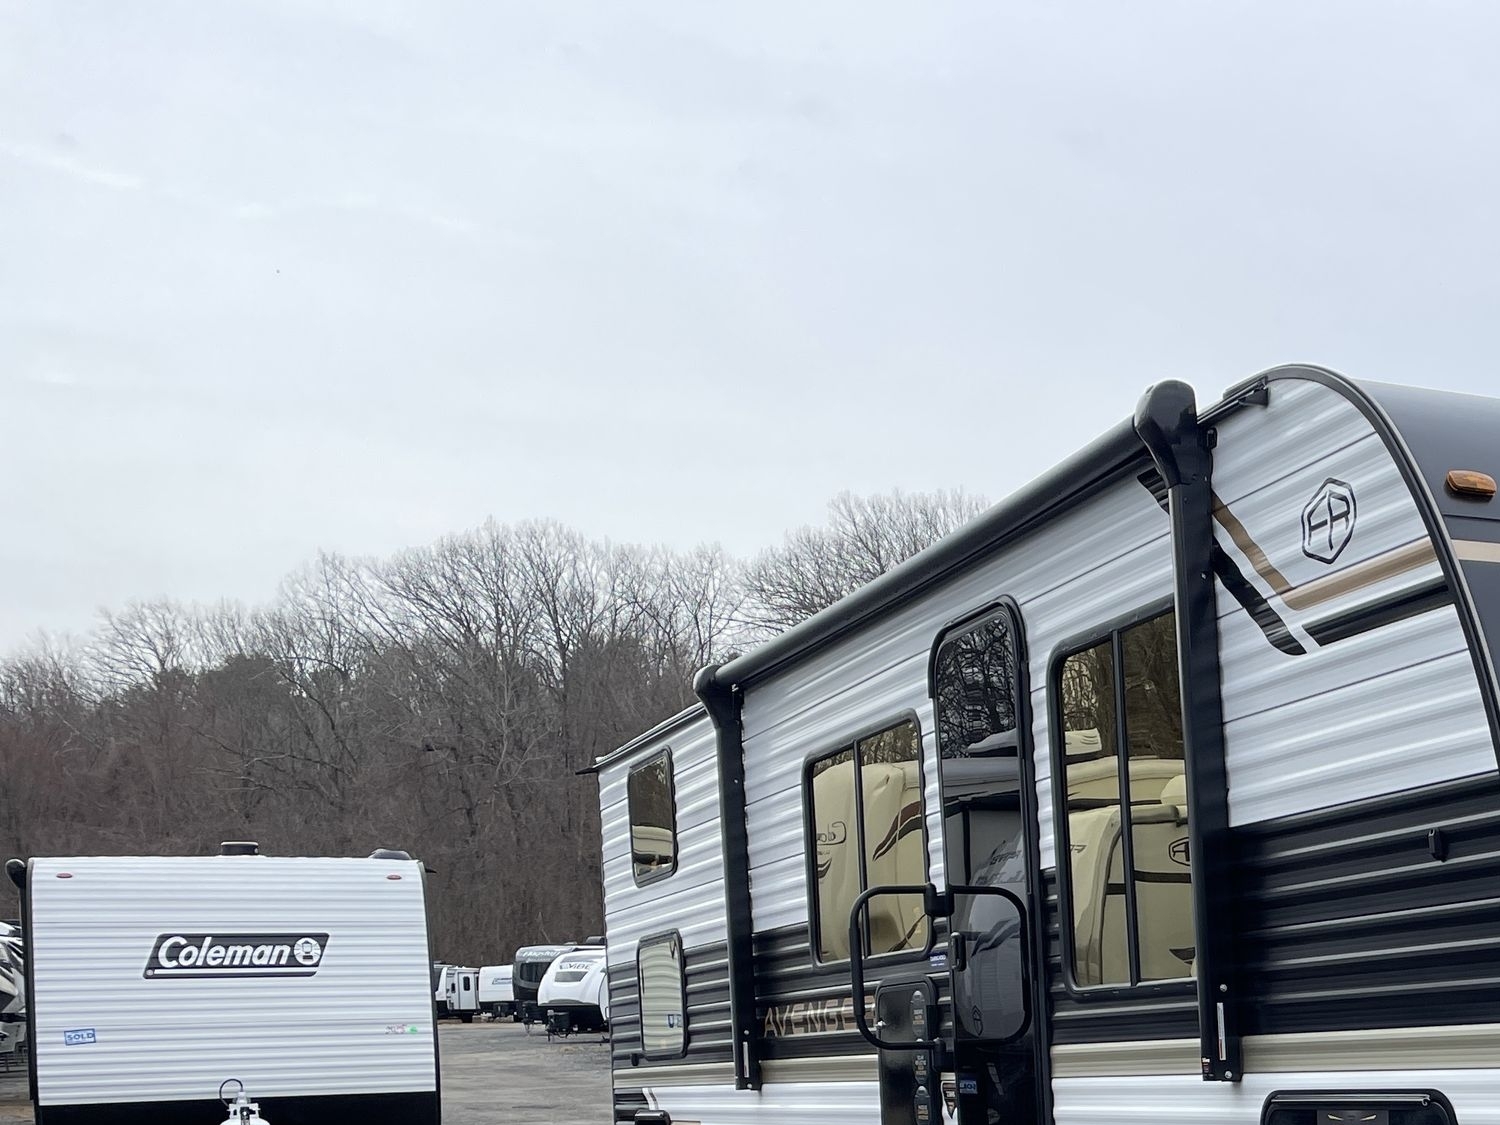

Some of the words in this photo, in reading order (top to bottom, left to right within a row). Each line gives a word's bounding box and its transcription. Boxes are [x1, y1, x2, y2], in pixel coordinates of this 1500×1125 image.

[157, 935, 292, 968] Coleman
[764, 995, 876, 1038] AVENGER
[67, 1032, 95, 1041] SOLD
